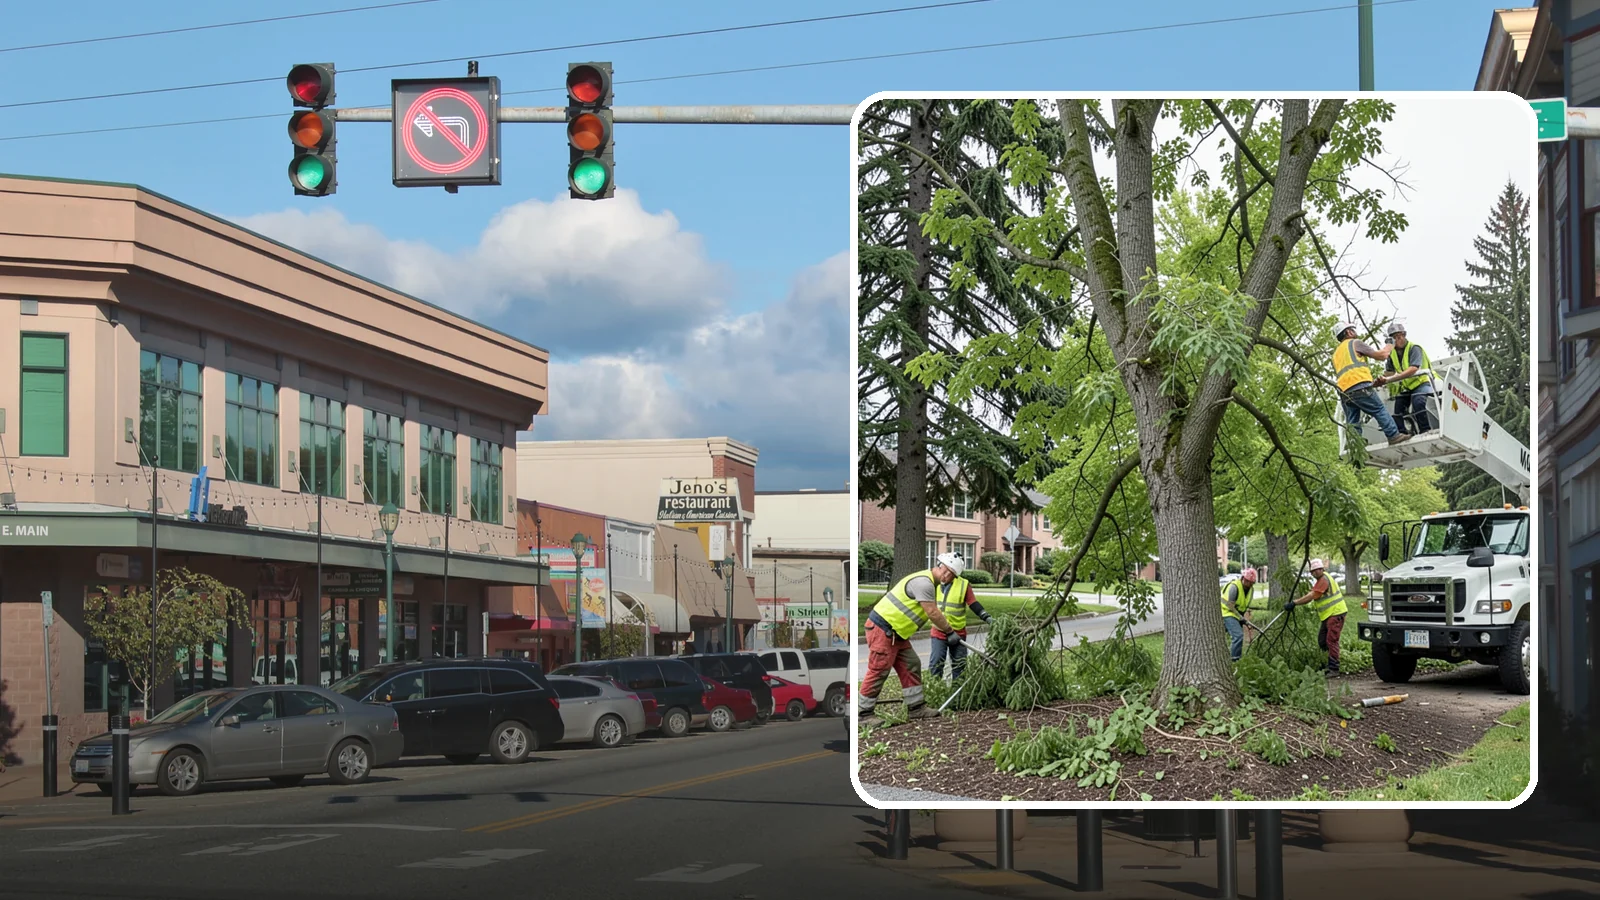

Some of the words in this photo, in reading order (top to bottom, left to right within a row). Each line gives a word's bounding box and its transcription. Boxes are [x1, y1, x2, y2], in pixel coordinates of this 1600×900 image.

[669, 480, 727, 494] Jeno's
[665, 496, 731, 509] restaurant
[658, 510, 681, 519] Italian
[686, 509, 714, 519] American
[715, 509, 737, 519] Cuisine
[2, 525, 13, 536] E.
[15, 525, 49, 536] MAIN
[797, 607, 828, 616] Street
